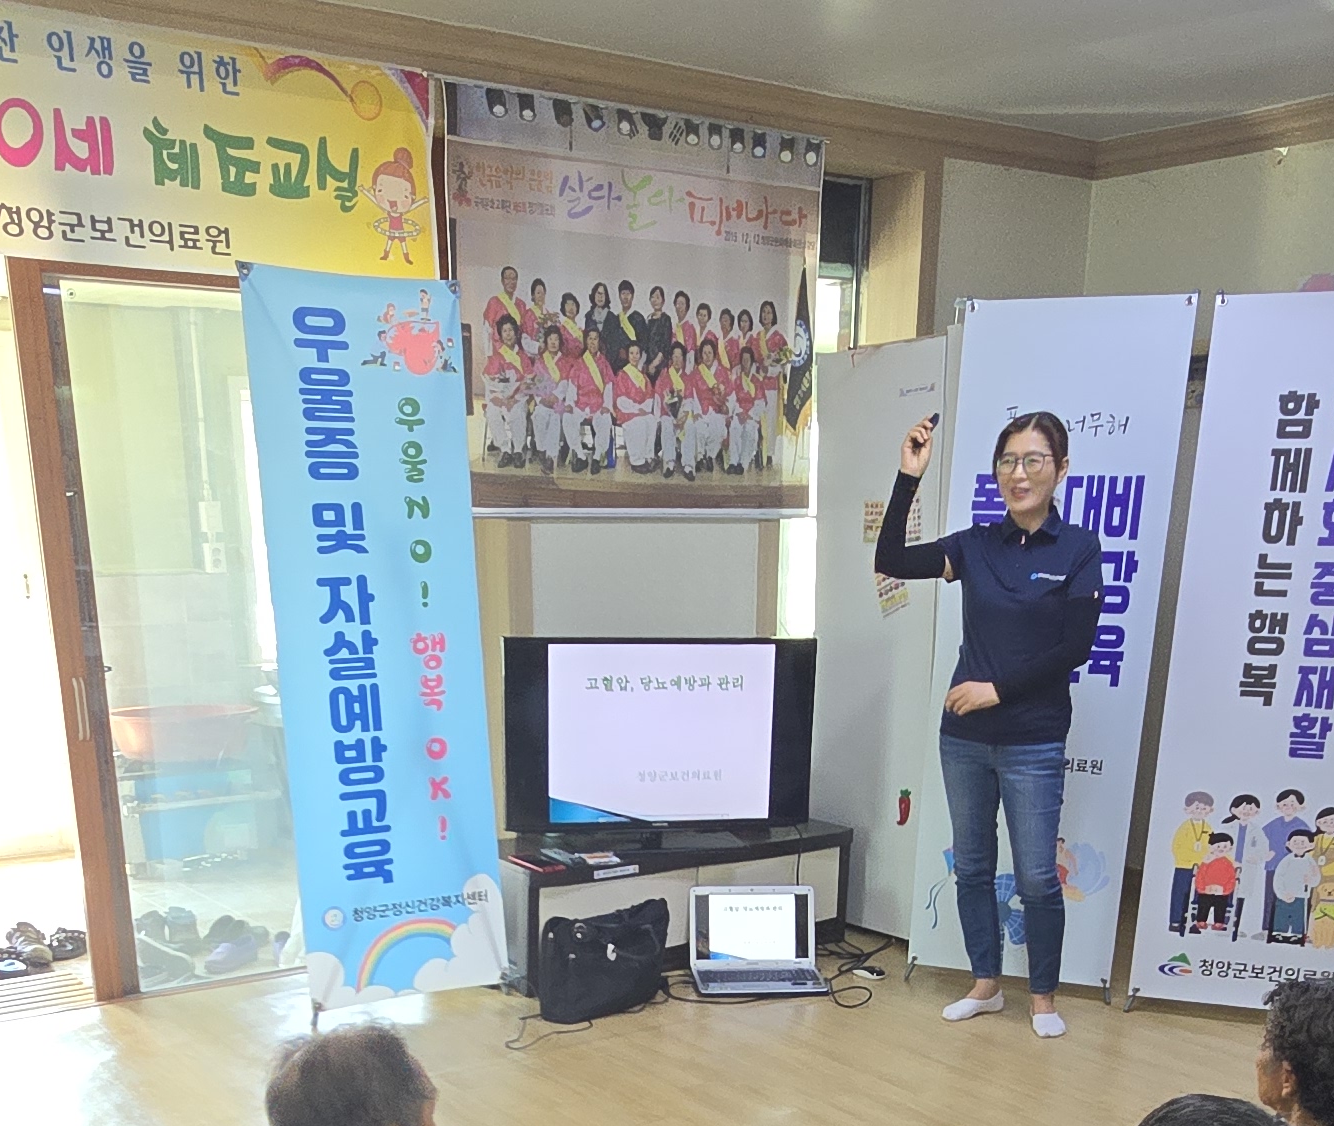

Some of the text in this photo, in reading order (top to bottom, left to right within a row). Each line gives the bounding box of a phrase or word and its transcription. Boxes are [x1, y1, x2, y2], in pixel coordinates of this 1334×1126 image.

[46, 30, 152, 84] 인생을
[178, 51, 241, 97] 위한
[1238, 390, 1321, 707] 함께하는 행복
[292, 306, 394, 884] 우울증 및 자살예방교육
[410, 632, 446, 712] 행복
[585, 675, 744, 692] 고혈압, 당뇨예방과 관리
